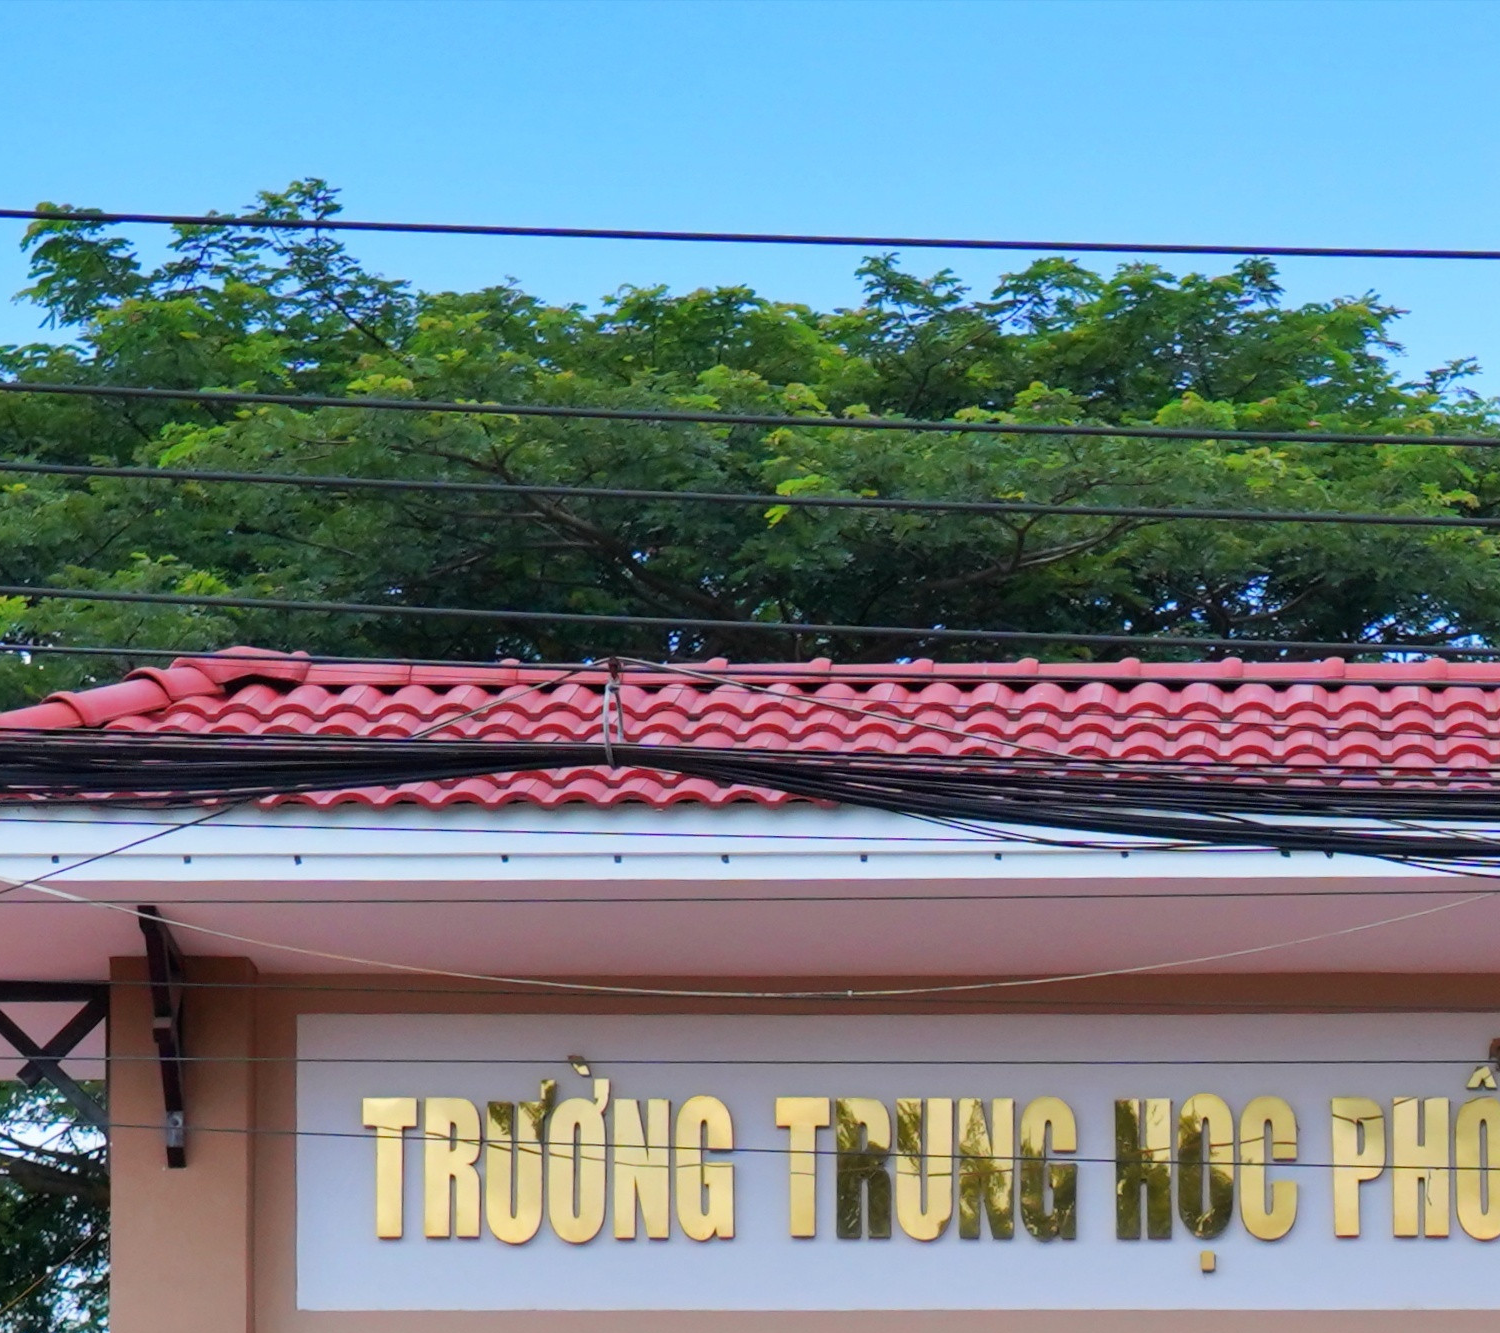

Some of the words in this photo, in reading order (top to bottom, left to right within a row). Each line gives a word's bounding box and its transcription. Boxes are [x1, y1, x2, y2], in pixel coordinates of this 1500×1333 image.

[362, 1054, 736, 1246] TRƯỜNG
[775, 1094, 1079, 1244] TRUNG
[1114, 1091, 1300, 1276] HỌC
